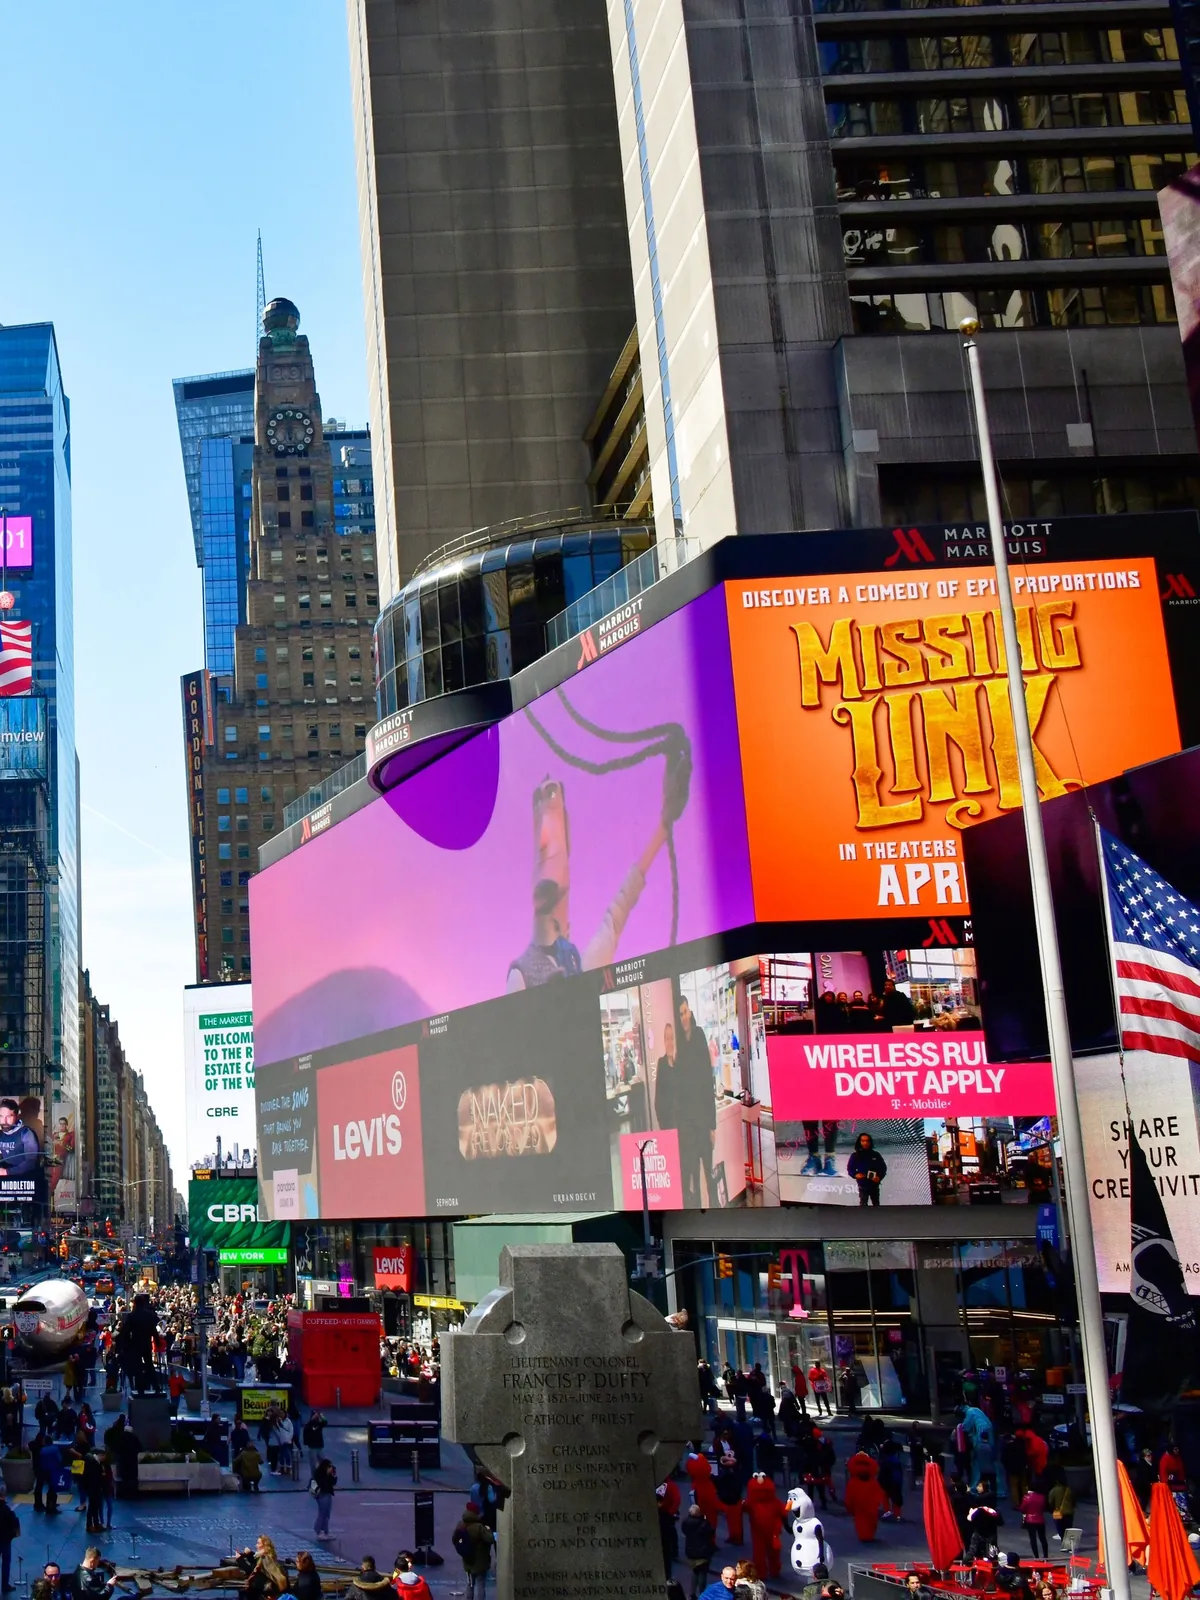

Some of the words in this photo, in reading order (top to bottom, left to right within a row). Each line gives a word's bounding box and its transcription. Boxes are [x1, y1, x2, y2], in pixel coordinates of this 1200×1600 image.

[944, 523, 1052, 540] MARIOTT
[946, 541, 1042, 557] MARUIS
[742, 587, 831, 608] DISCOVER
[838, 586, 850, 603] A
[855, 582, 931, 602] COMEDY
[936, 581, 958, 598] OF
[966, 578, 997, 597] EPI
[1014, 570, 1141, 594] PROPORTIONS
[598, 598, 643, 635] MARRIOTT
[600, 618, 639, 651] MARQUIS
[788, 600, 1083, 710] MISSING
[374, 711, 414, 741] MARRIOTT
[189, 681, 203, 790] GORDON
[375, 727, 409, 754] MARQUIS
[831, 673, 1090, 830] LINK
[311, 803, 333, 823] MARRIOTT
[311, 815, 331, 835] MARQUIS
[839, 843, 857, 860] IN
[862, 840, 957, 860] THEATERS
[615, 959, 646, 974] MARRIOTT
[820, 954, 833, 978] NYC
[616, 971, 643, 985] MARQUIS
[204, 1018, 218, 1026] THE
[219, 1015, 248, 1025] MARKET
[430, 1015, 449, 1026] MARRIOTT
[430, 1024, 448, 1035] MARQUIS
[204, 1049, 218, 1061] TO
[221, 1047, 242, 1060] THE
[803, 1042, 940, 1069] WIRELESS
[205, 1062, 242, 1076] ESTATE
[205, 1078, 218, 1091] OF
[222, 1077, 243, 1090] THE
[834, 1071, 918, 1096] DON'T
[922, 1069, 1006, 1095] APPLY
[292, 1087, 309, 1111] SONG
[472, 1083, 539, 1128] NAKED
[206, 1107, 238, 1117] CBRE
[1110, 1116, 1180, 1142] SHARE
[1117, 1146, 1178, 1169] YUR
[1, 1180, 35, 1190] MIDDLETON
[277, 1182, 295, 1193] pandora
[806, 1183, 844, 1195] Galaxy
[1092, 1174, 1200, 1199] CREIVIT
[436, 1197, 459, 1207] SEPHORA
[553, 1193, 574, 1203] URBAN
[575, 1192, 596, 1201] DECAY
[240, 1252, 264, 1260] YORK
[511, 1356, 579, 1368] LIEUTENANT
[584, 1356, 640, 1368] COLONEL
[503, 1372, 572, 1388] FRANCIS
[595, 1372, 651, 1388] DUFFY
[512, 1393, 534, 1403] MAY
[524, 1414, 584, 1425] CATHOLIC
[591, 1413, 635, 1424] PRIEST
[552, 1444, 610, 1456] CHAPLAIN
[527, 1463, 558, 1474] 165TH
[586, 1462, 640, 1474] INFANTRY
[543, 1480, 566, 1490] OLD
[545, 1513, 569, 1523] LIFE
[573, 1513, 590, 1523] OF
[594, 1512, 642, 1523] SERVICE
[576, 1526, 597, 1535] FOR
[528, 1538, 555, 1549] GOD
[560, 1538, 586, 1549] AND
[590, 1537, 649, 1548] COUNTRY
[526, 1571, 568, 1581] SPANISH
[572, 1570, 625, 1581] AMERICAN
[629, 1570, 652, 1580] WAR
[514, 1587, 539, 1598] NEW
[573, 1586, 625, 1597] NATIONAL
[629, 1585, 666, 1595] GUARD
